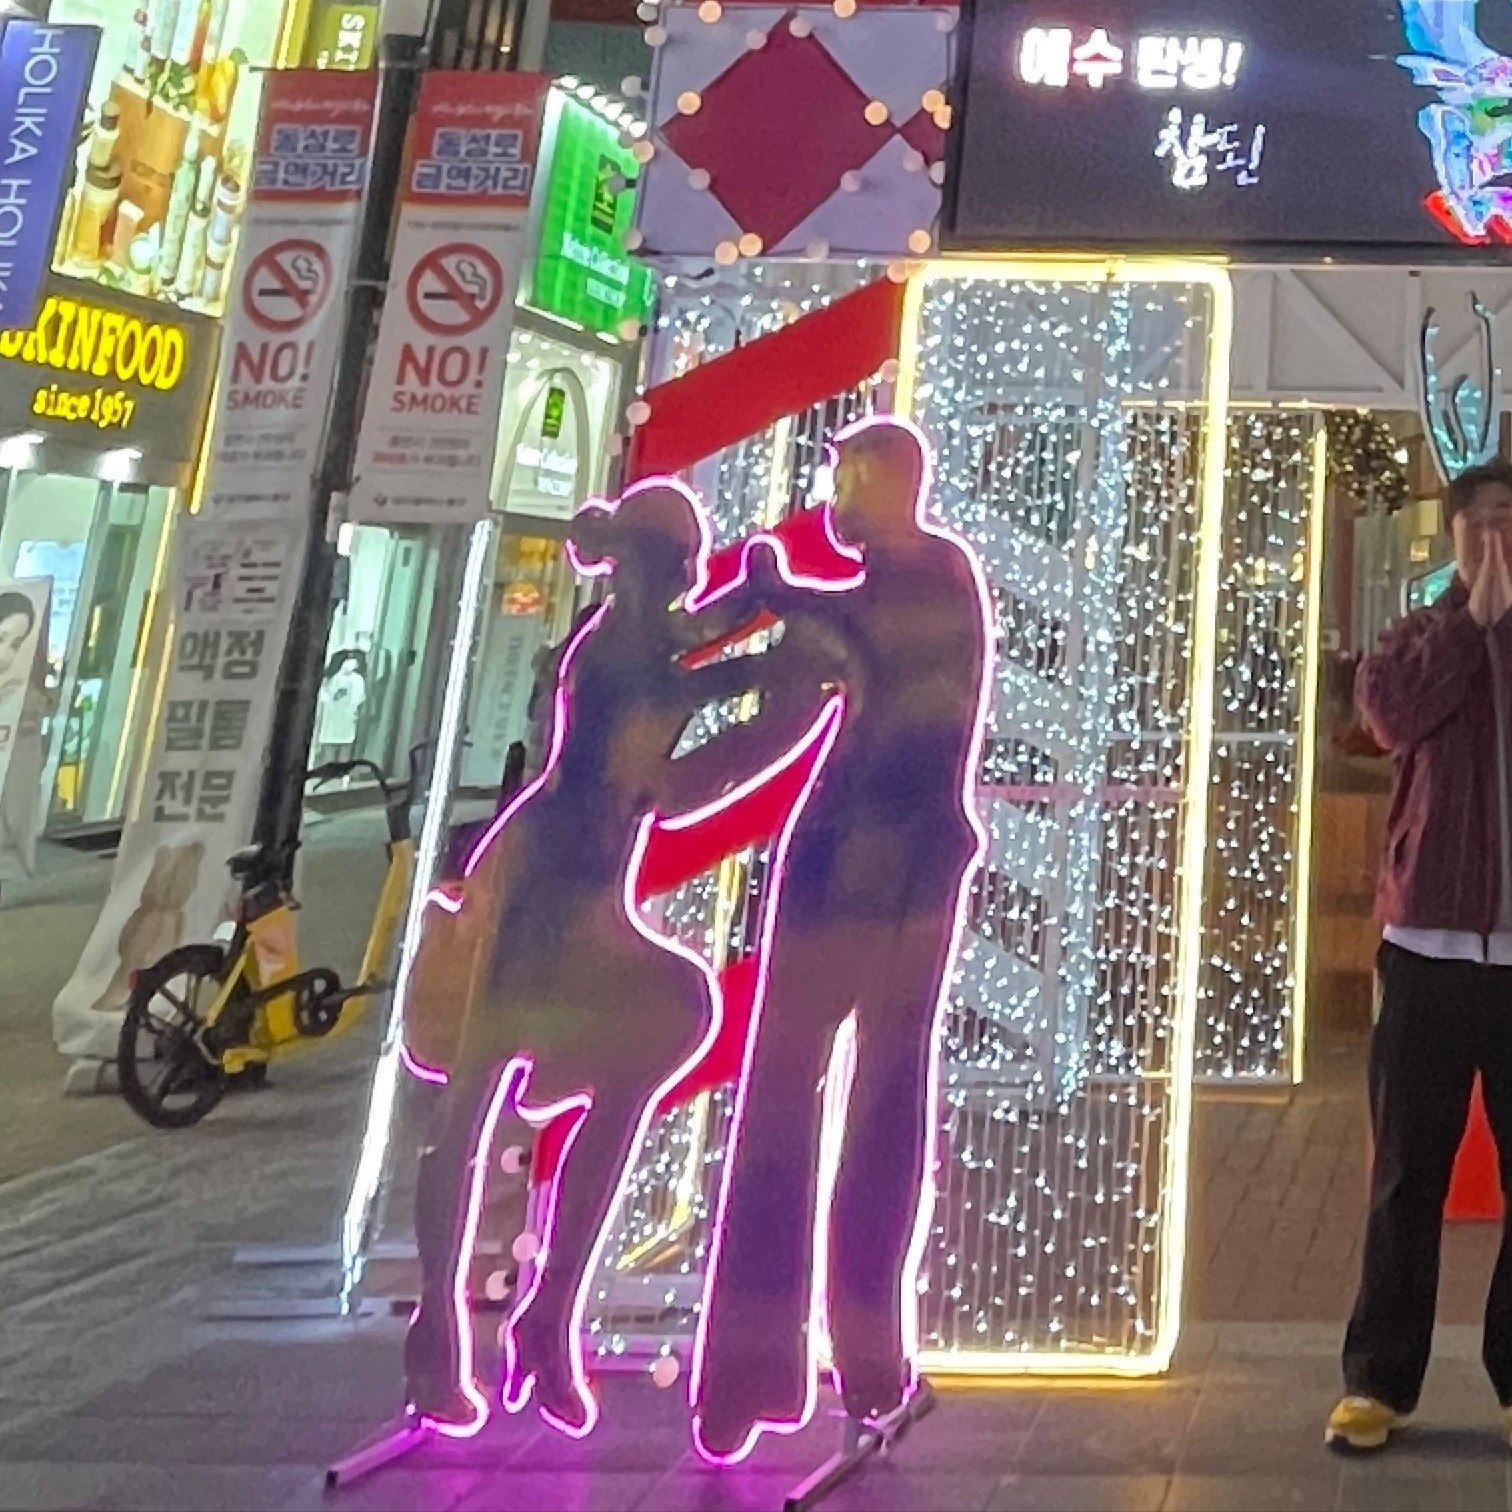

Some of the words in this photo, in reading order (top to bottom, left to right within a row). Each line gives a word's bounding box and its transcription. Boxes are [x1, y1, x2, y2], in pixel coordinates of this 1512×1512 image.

[335, 13, 366, 70] SKI
[5, 28, 65, 165] HOLIKA
[271, 123, 361, 157] 동성로
[433, 127, 522, 160] 동성로
[412, 161, 534, 194] 금연거리
[230, 340, 316, 385] NO!
[395, 342, 490, 389] NO!
[33, 384, 91, 420] since
[226, 388, 307, 411] SMOKE
[391, 391, 482, 416] SMOKE
[178, 629, 266, 681] 액정
[164, 699, 252, 752] 필름
[152, 769, 236, 823] 전문
